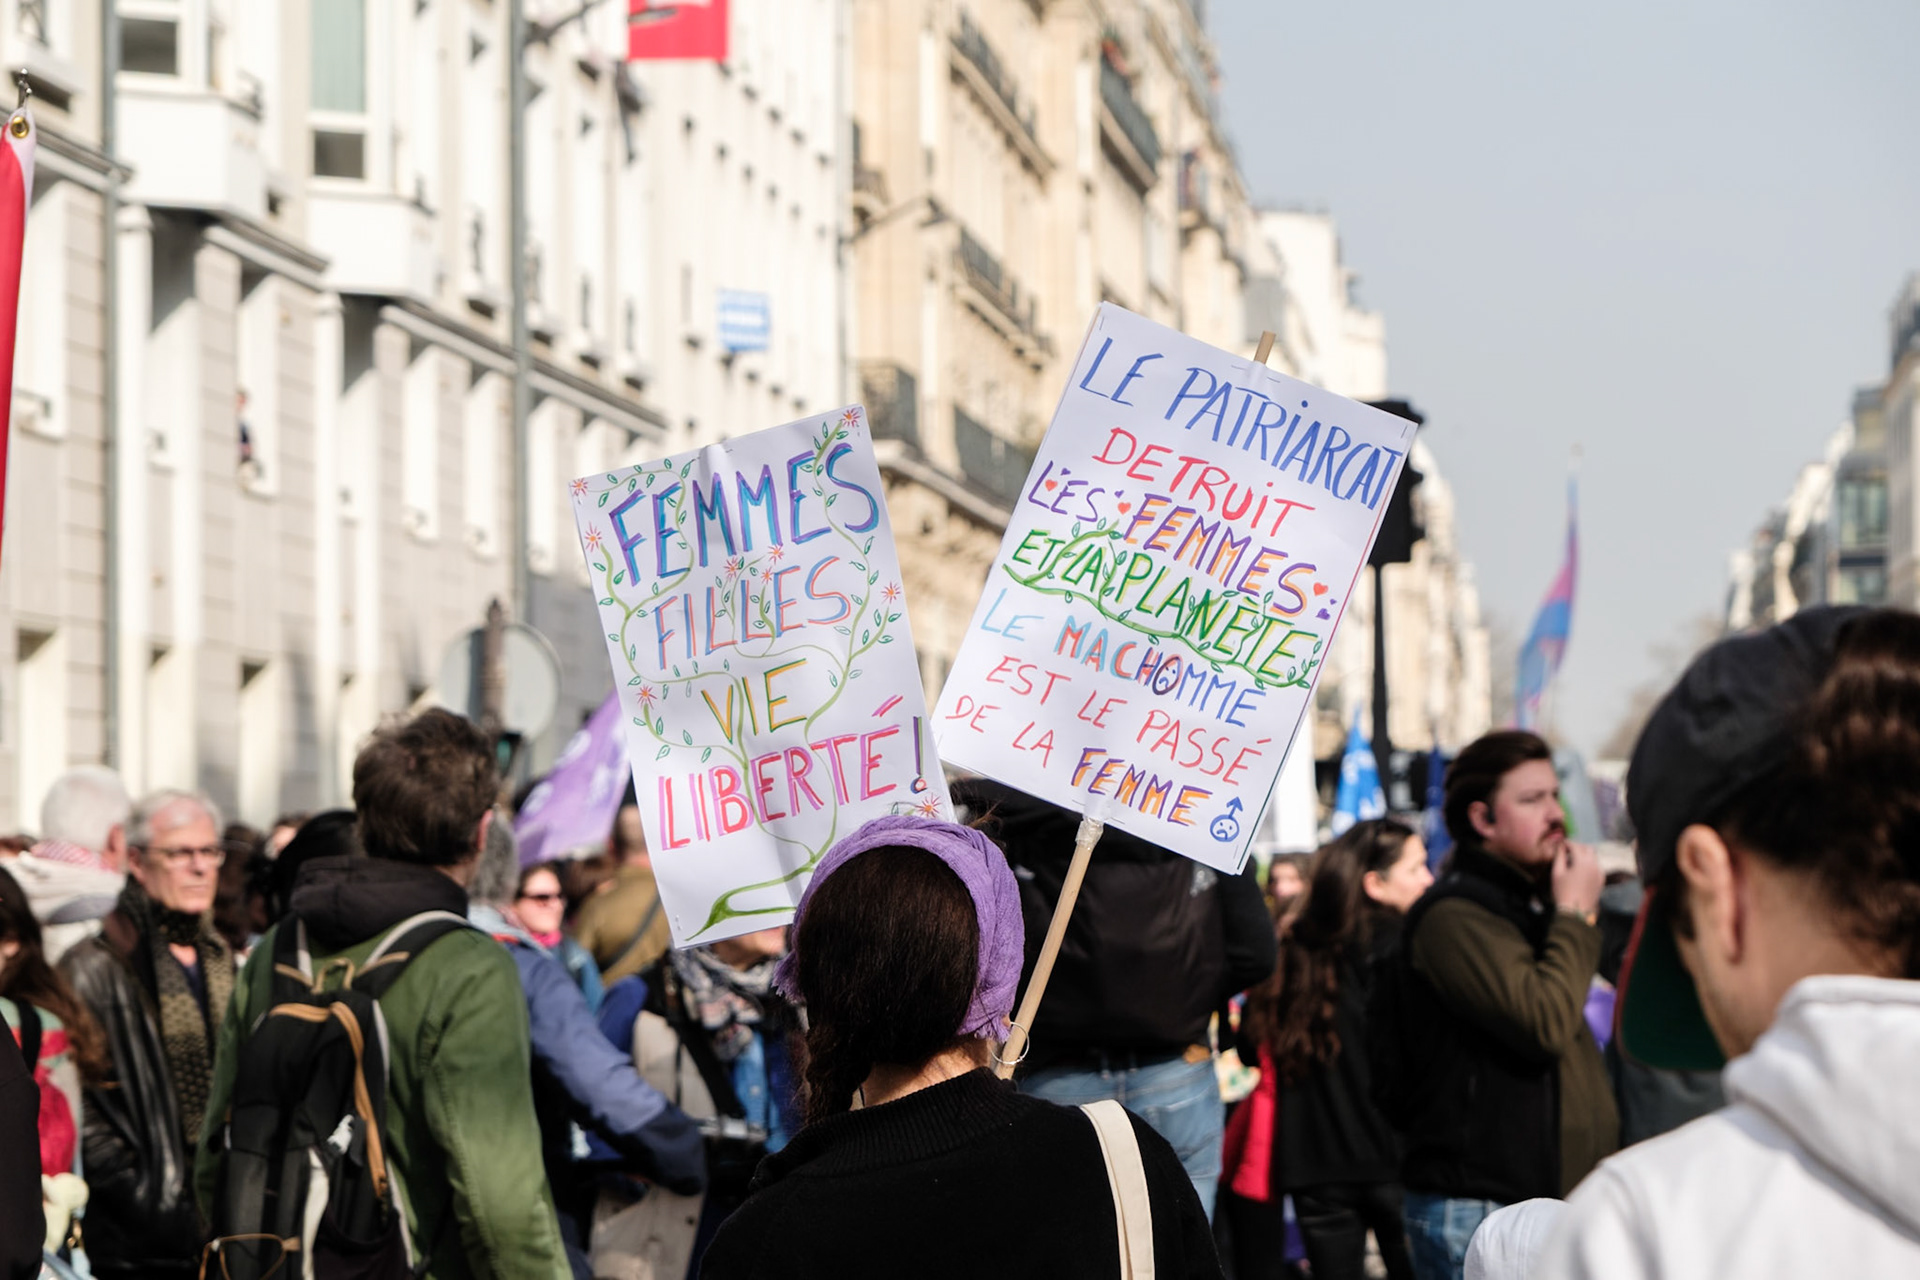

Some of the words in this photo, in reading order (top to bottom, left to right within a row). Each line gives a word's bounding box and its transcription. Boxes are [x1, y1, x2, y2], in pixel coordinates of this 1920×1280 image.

[1079, 337, 1164, 407] LE
[609, 442, 880, 587] FEMMES
[1028, 460, 1105, 522] LES
[1123, 493, 1318, 617] FEMMES
[651, 556, 851, 670] FILLES
[981, 588, 1045, 641] LE
[1053, 615, 1267, 728] MACHOMME
[1012, 529, 1067, 571] ET
[1061, 543, 1107, 593] LA
[1114, 552, 1319, 679] PLANÈTE
[701, 658, 807, 744] VIE
[945, 695, 1001, 733] DE
[1012, 721, 1055, 768] LA
[1070, 747, 1214, 826] FEMME
[986, 655, 1072, 705] EST
[1077, 690, 1128, 729] LE
[1136, 709, 1272, 786] PASSÉ
